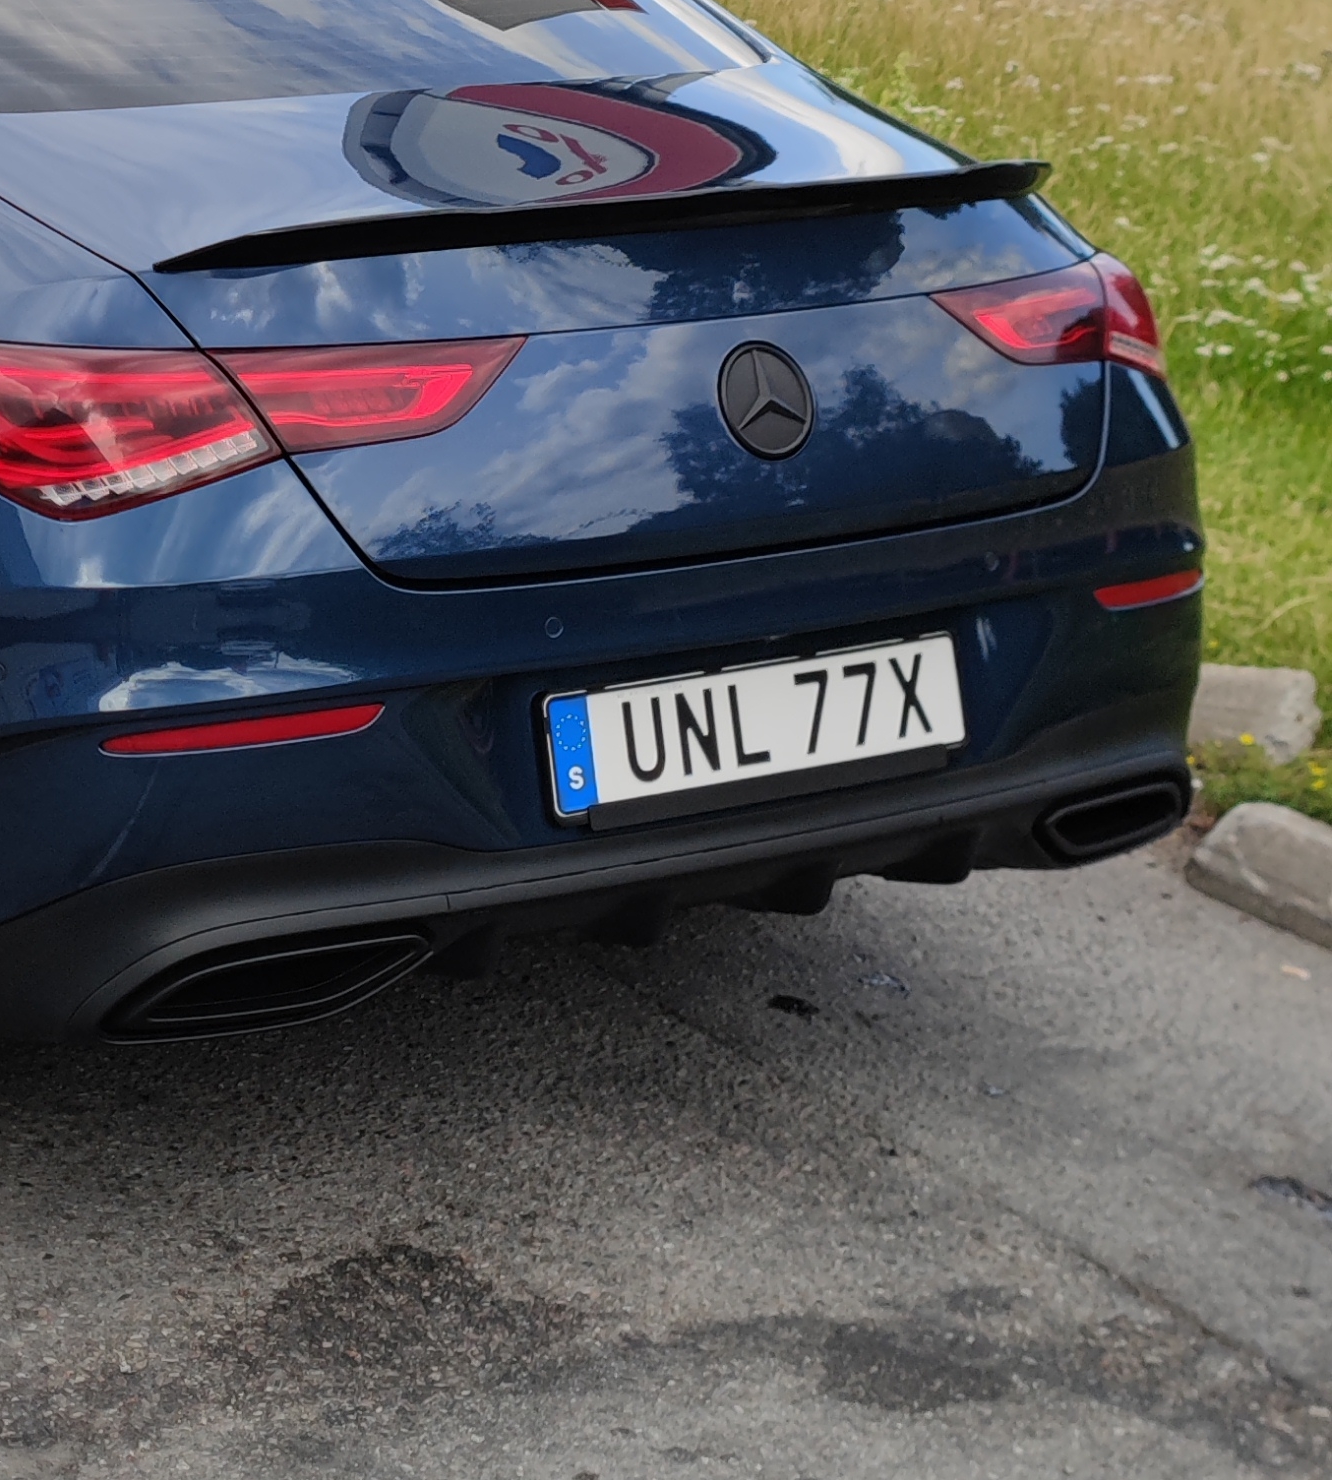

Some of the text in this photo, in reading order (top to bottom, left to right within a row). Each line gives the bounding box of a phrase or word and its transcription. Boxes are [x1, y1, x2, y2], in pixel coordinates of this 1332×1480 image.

[621, 653, 933, 783] UNL 77X
[568, 766, 585, 791] S
